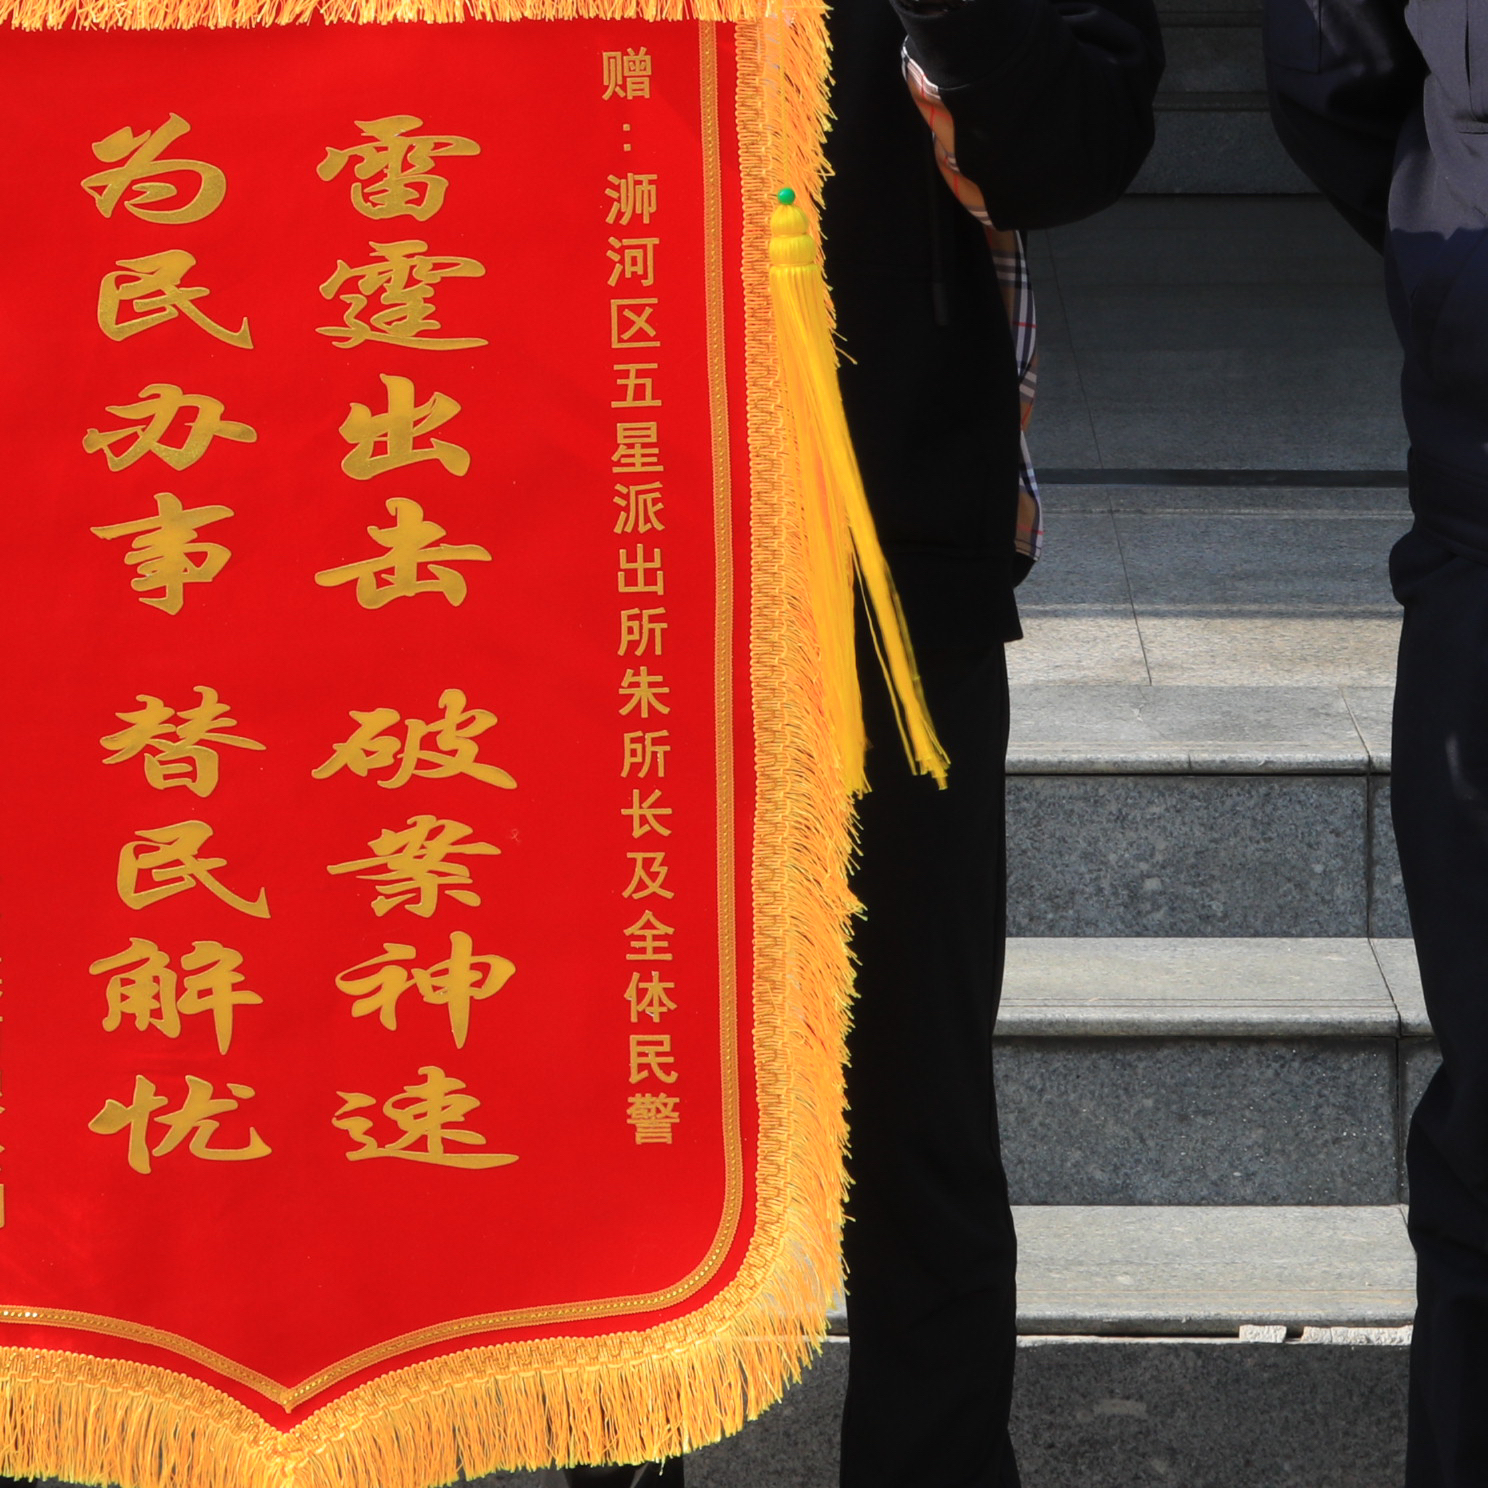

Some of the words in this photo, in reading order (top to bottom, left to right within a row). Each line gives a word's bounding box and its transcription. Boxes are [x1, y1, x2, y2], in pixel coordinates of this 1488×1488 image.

[80, 112, 258, 616] 为民办事
[313, 114, 494, 610] 雷霆出击
[87, 685, 274, 1175] 替民解忧
[311, 688, 520, 1170] 破案神速
